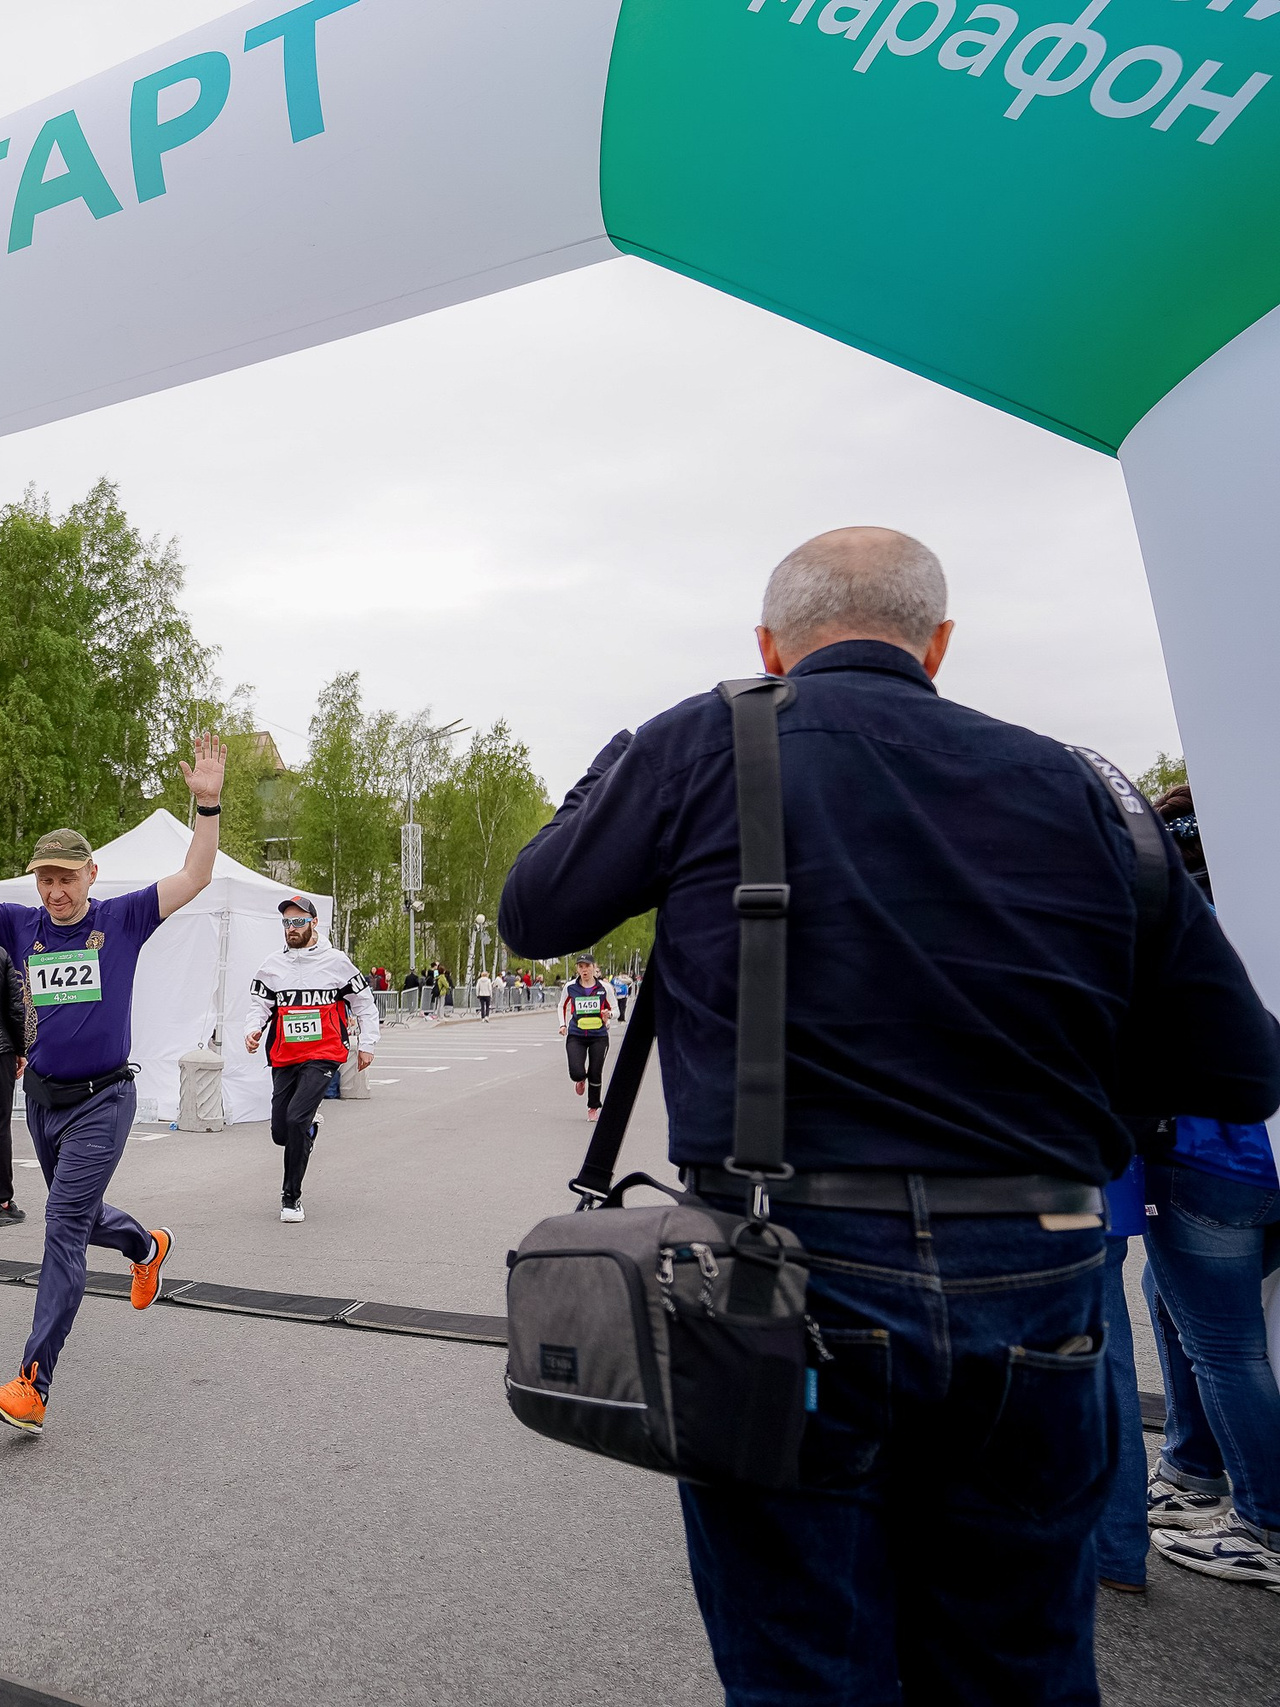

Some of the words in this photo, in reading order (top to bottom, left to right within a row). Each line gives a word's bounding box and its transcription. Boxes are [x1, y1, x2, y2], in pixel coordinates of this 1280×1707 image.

[746, 0, 1273, 146] арафон
[37, 965, 93, 989] 1422
[578, 1001, 598, 1009] 1450
[287, 1021, 317, 1034] 1551
